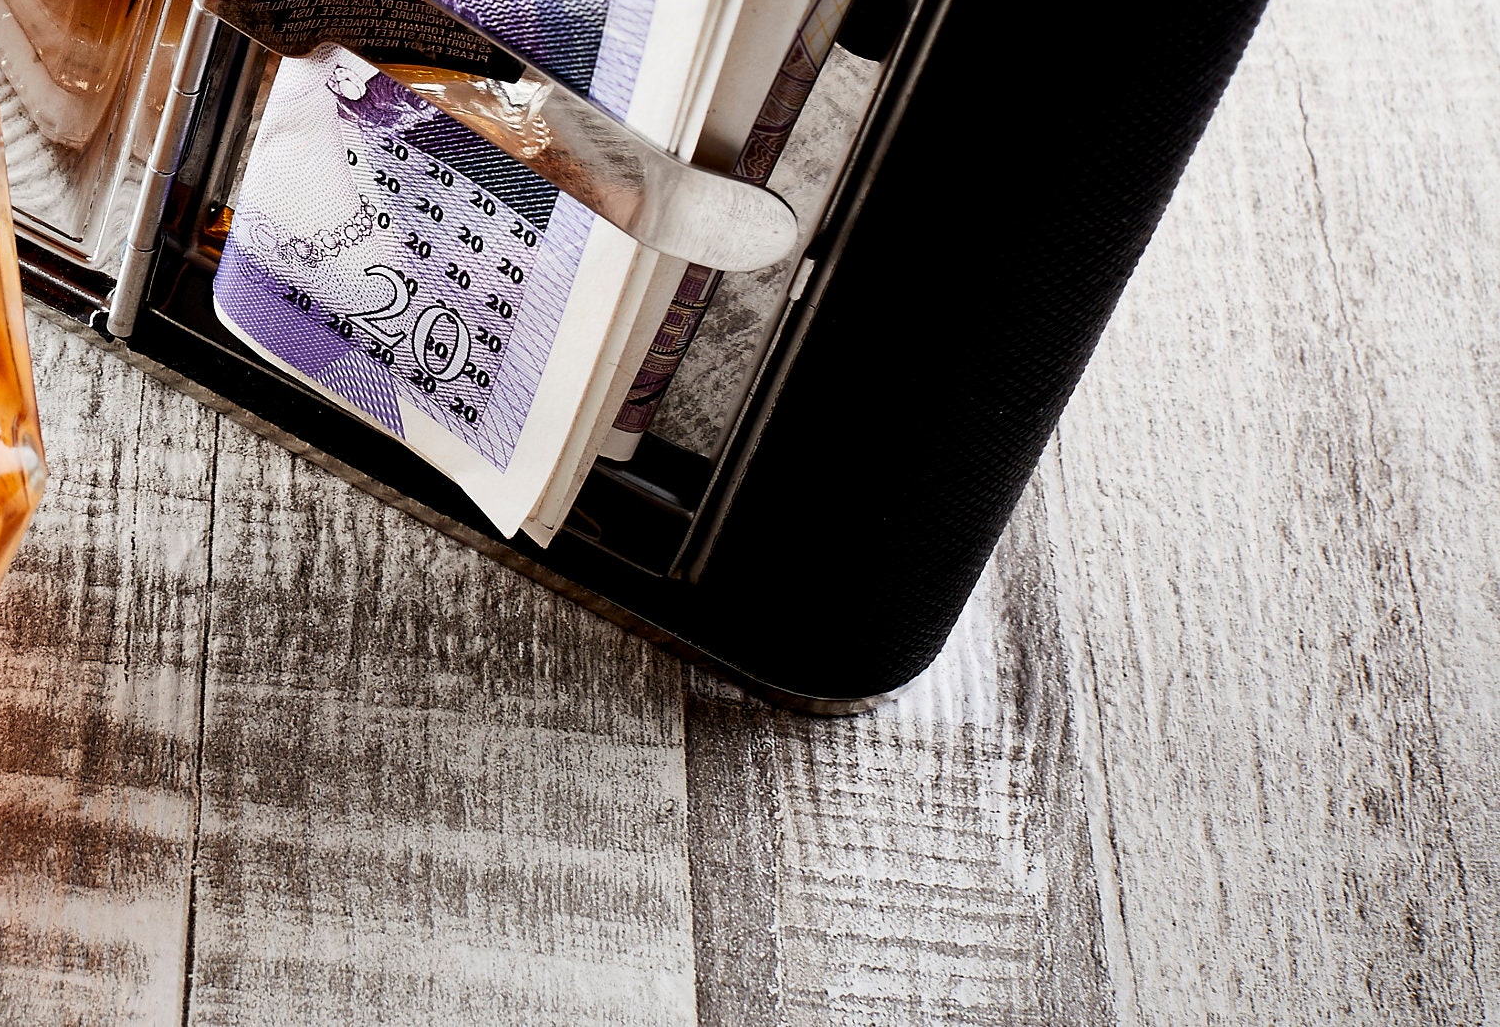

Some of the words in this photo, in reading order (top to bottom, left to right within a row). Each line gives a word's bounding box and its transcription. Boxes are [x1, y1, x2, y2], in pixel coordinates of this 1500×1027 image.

[379, 137, 409, 162] 20
[373, 170, 401, 195] 20
[424, 162, 454, 187] 20
[415, 197, 444, 223] 20
[469, 190, 496, 217] 20
[404, 232, 432, 259] 20
[458, 226, 484, 253] 20
[510, 221, 537, 248] 20
[446, 262, 471, 290] 20
[497, 257, 524, 284] 20
[284, 285, 312, 313] 20
[485, 293, 513, 319] 20
[327, 313, 354, 339] 20
[345, 264, 471, 382] 20
[368, 340, 395, 366] 20
[475, 326, 502, 354] 20
[411, 369, 437, 394] 20
[465, 362, 491, 388] 20
[451, 397, 478, 424] 20
